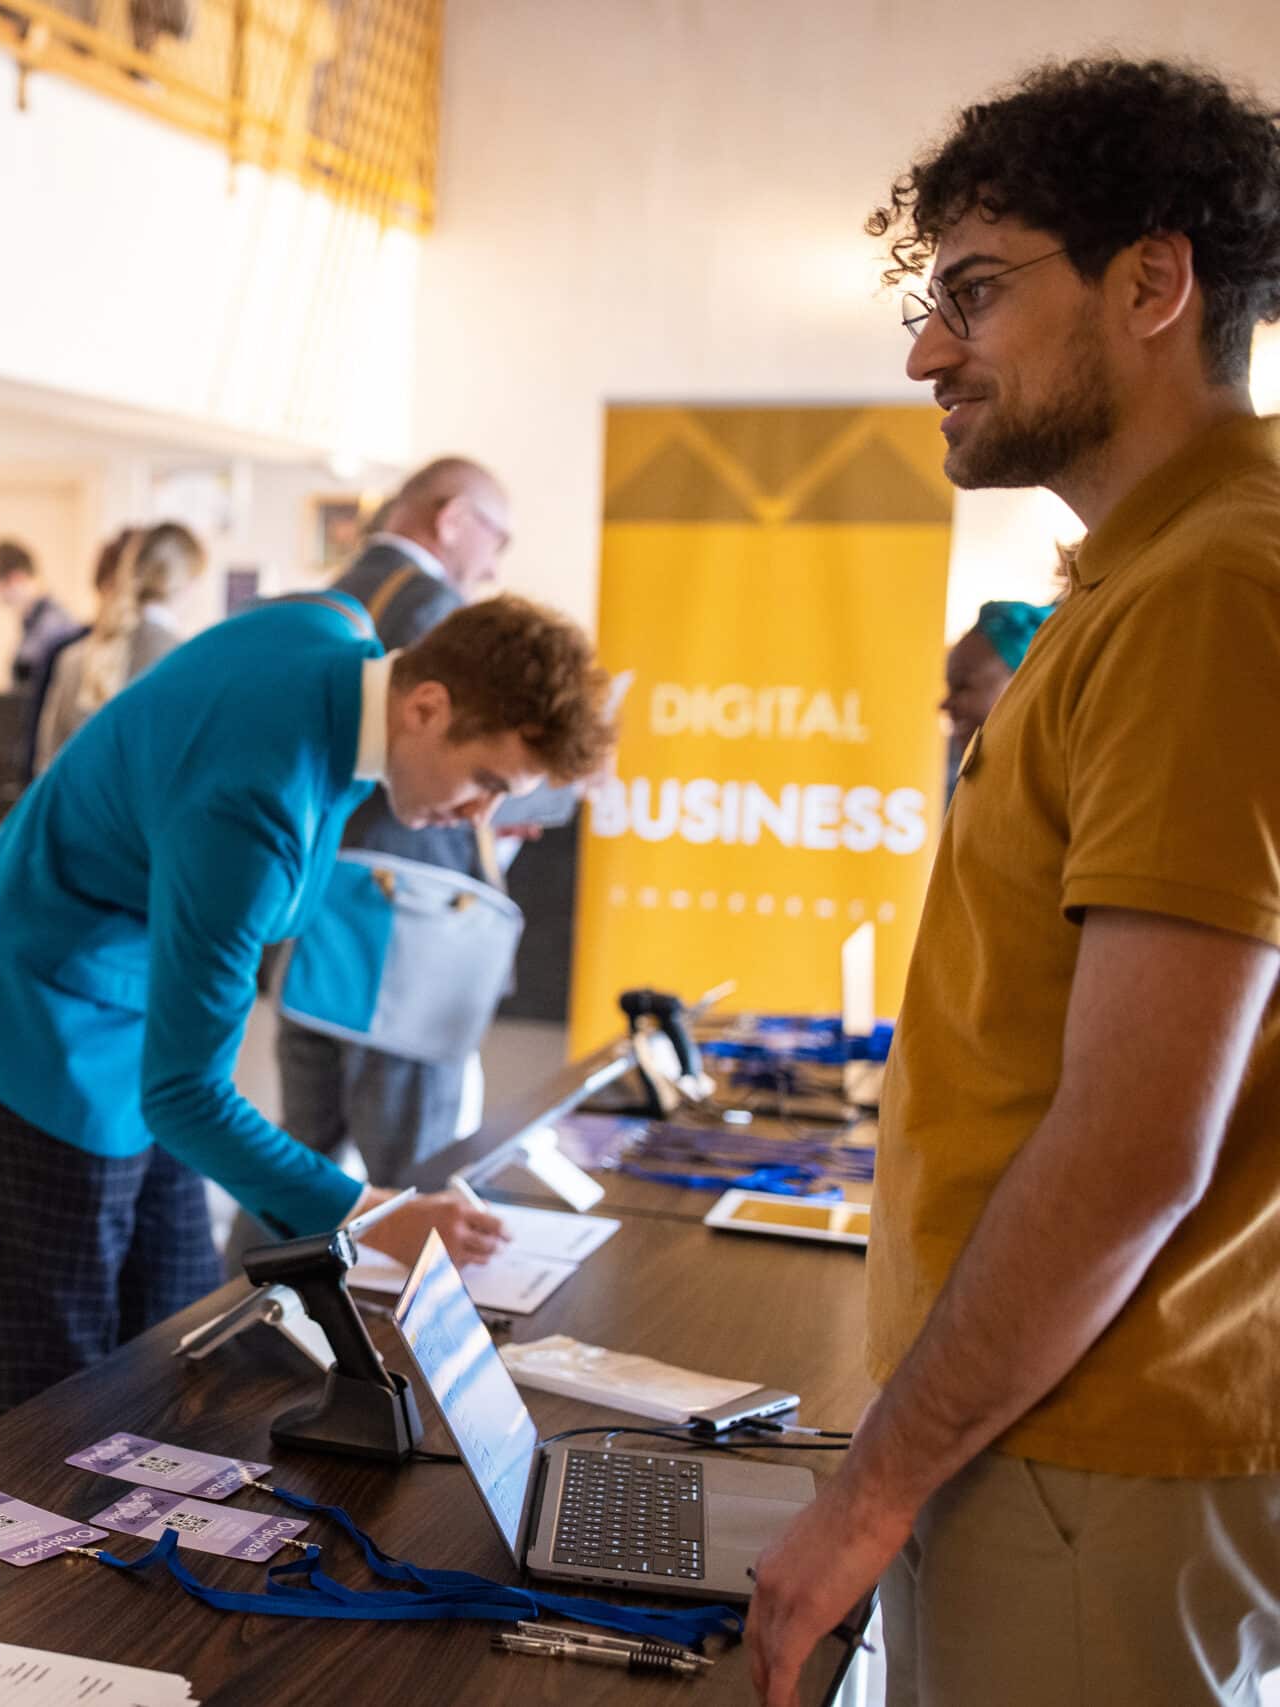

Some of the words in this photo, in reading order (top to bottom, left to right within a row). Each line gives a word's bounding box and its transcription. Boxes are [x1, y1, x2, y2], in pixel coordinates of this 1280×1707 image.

[650, 684, 869, 742] DIGITAL
[591, 777, 926, 854] BUSINESS
[12, 1530, 94, 1559] Organizer
[241, 1521, 295, 1556] Organizer
